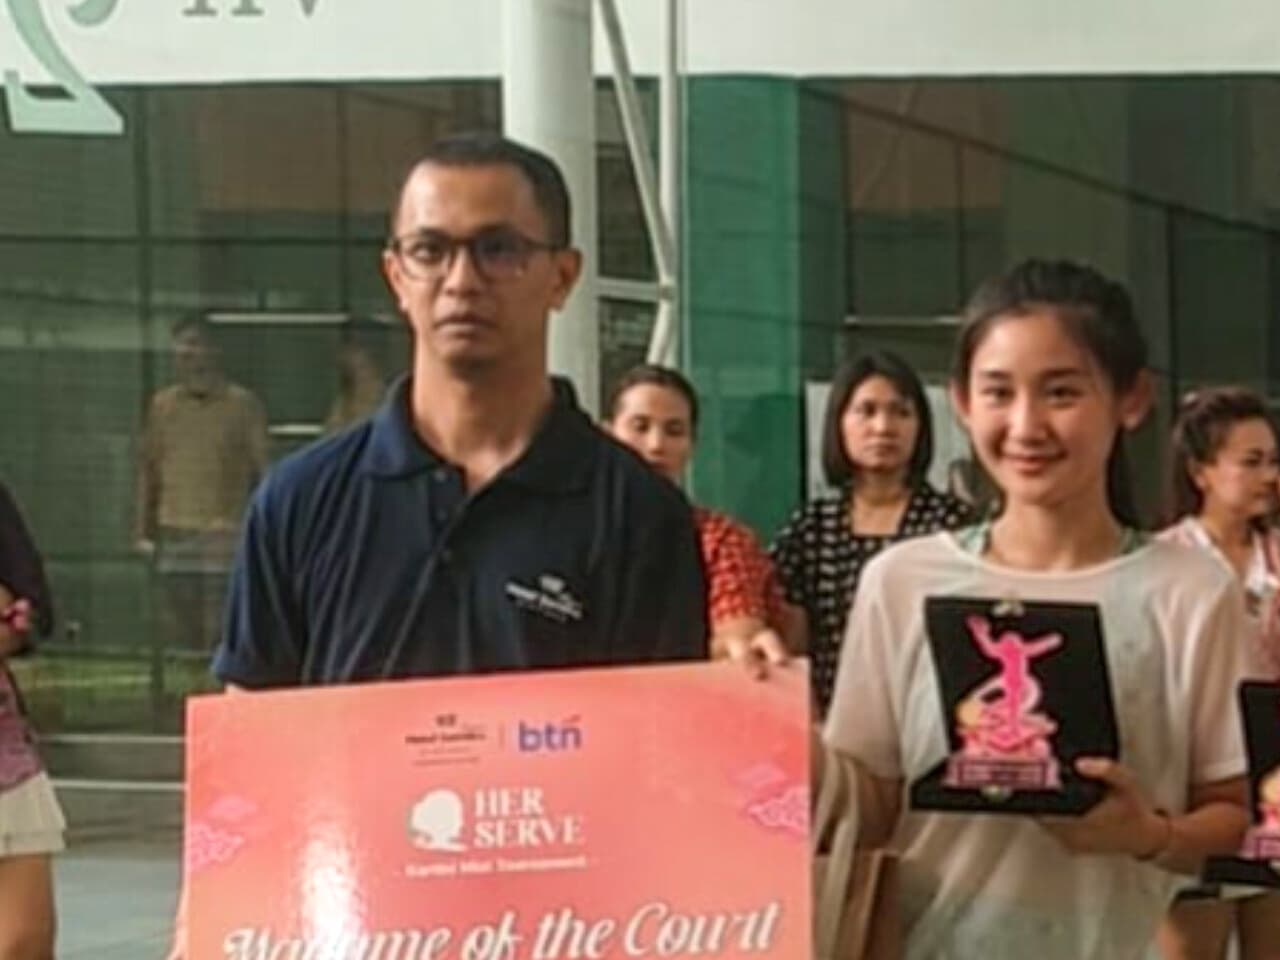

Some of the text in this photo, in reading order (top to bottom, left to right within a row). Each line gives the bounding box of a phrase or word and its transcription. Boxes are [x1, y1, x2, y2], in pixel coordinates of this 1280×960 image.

[475, 787, 545, 818] HER
[474, 816, 585, 849] SERVE
[624, 902, 780, 957] Court
